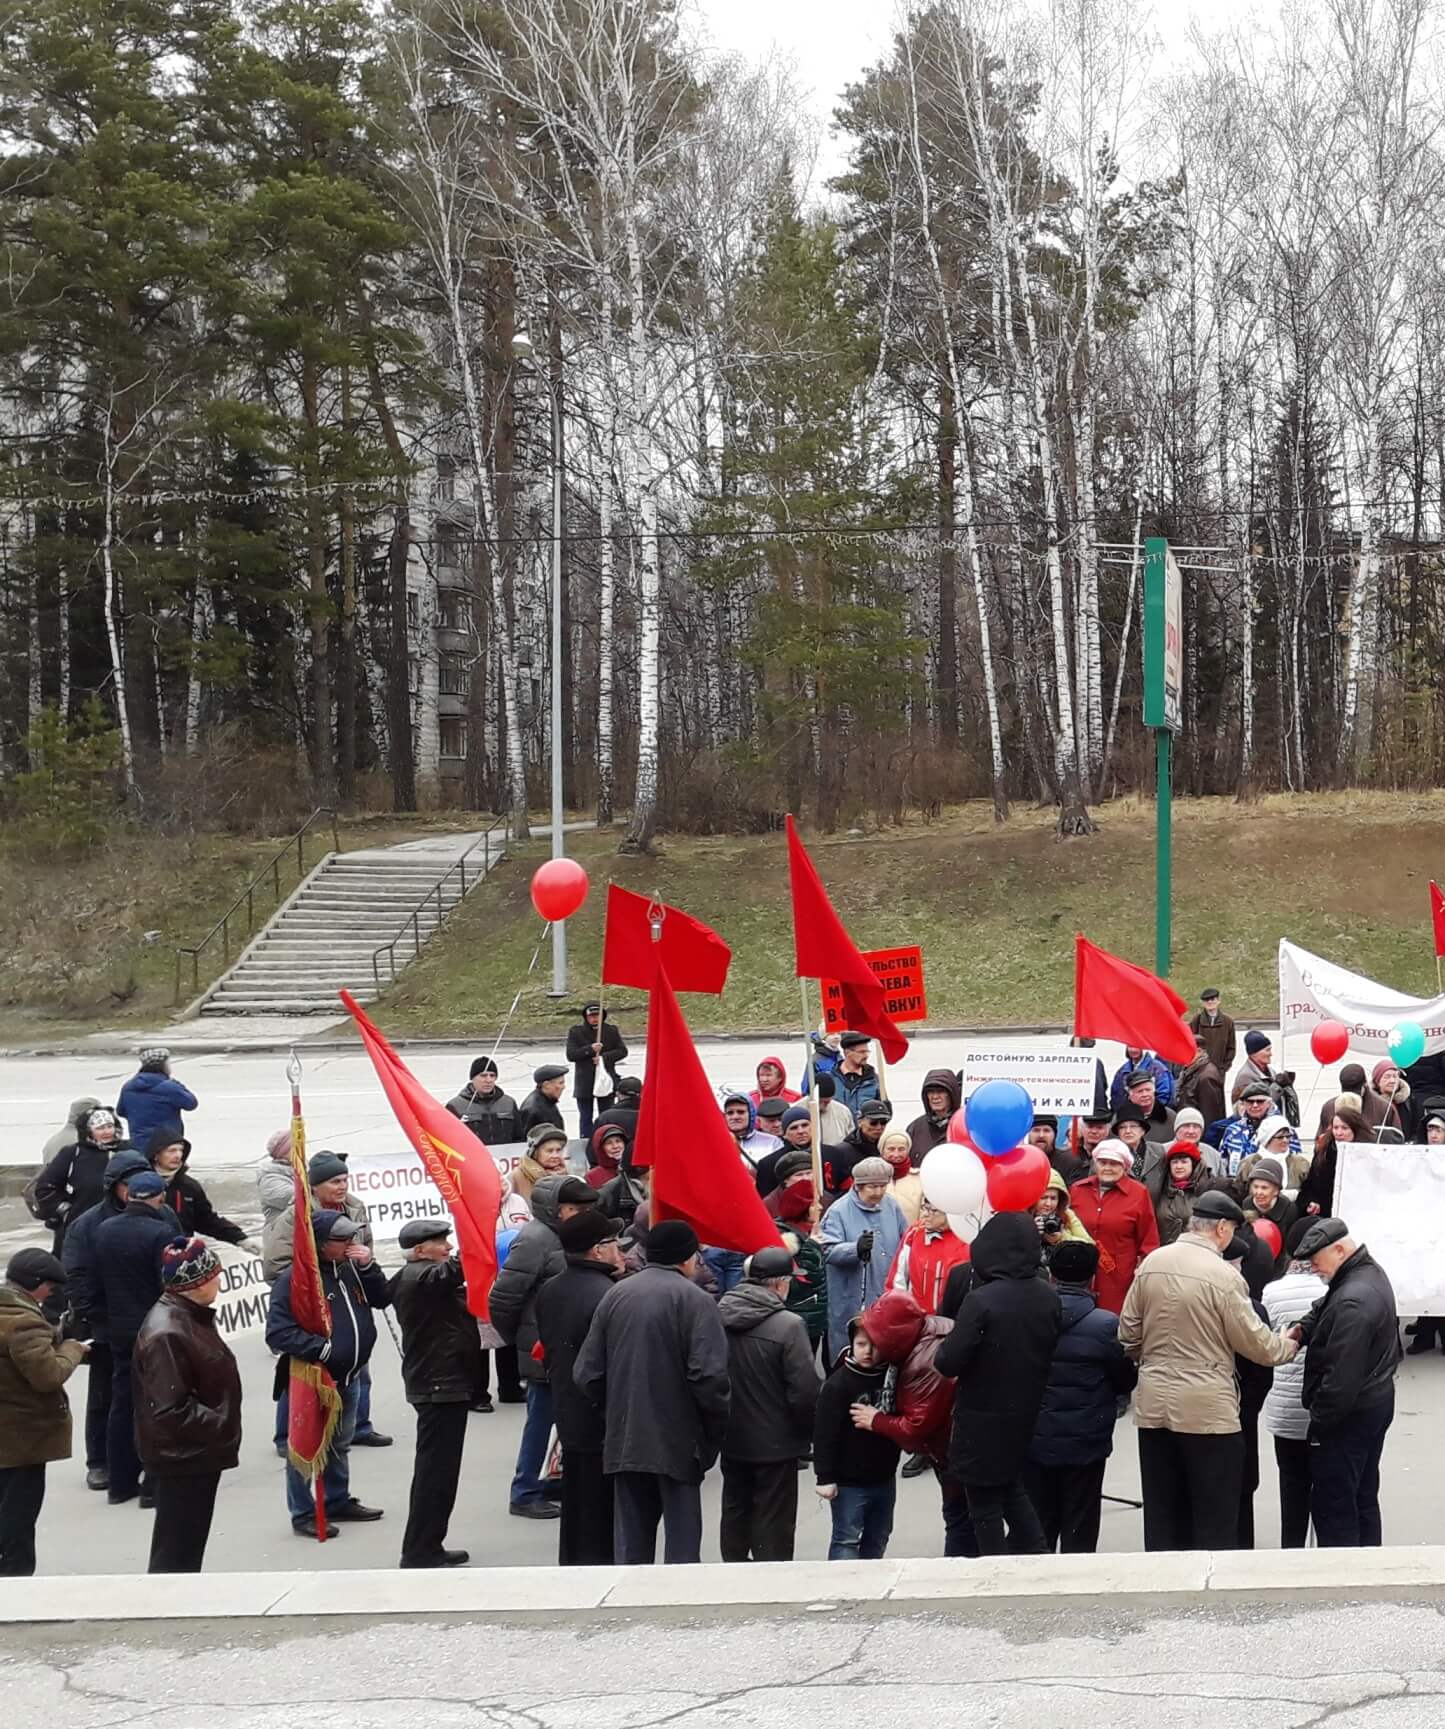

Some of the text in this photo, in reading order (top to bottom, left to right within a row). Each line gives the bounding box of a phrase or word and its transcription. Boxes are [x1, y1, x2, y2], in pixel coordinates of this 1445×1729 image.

[868, 956, 917, 972] ЛЬСТВО
[966, 1053, 1092, 1064] ДОСТОЙНУЮ ЗАРПЛАТУ
